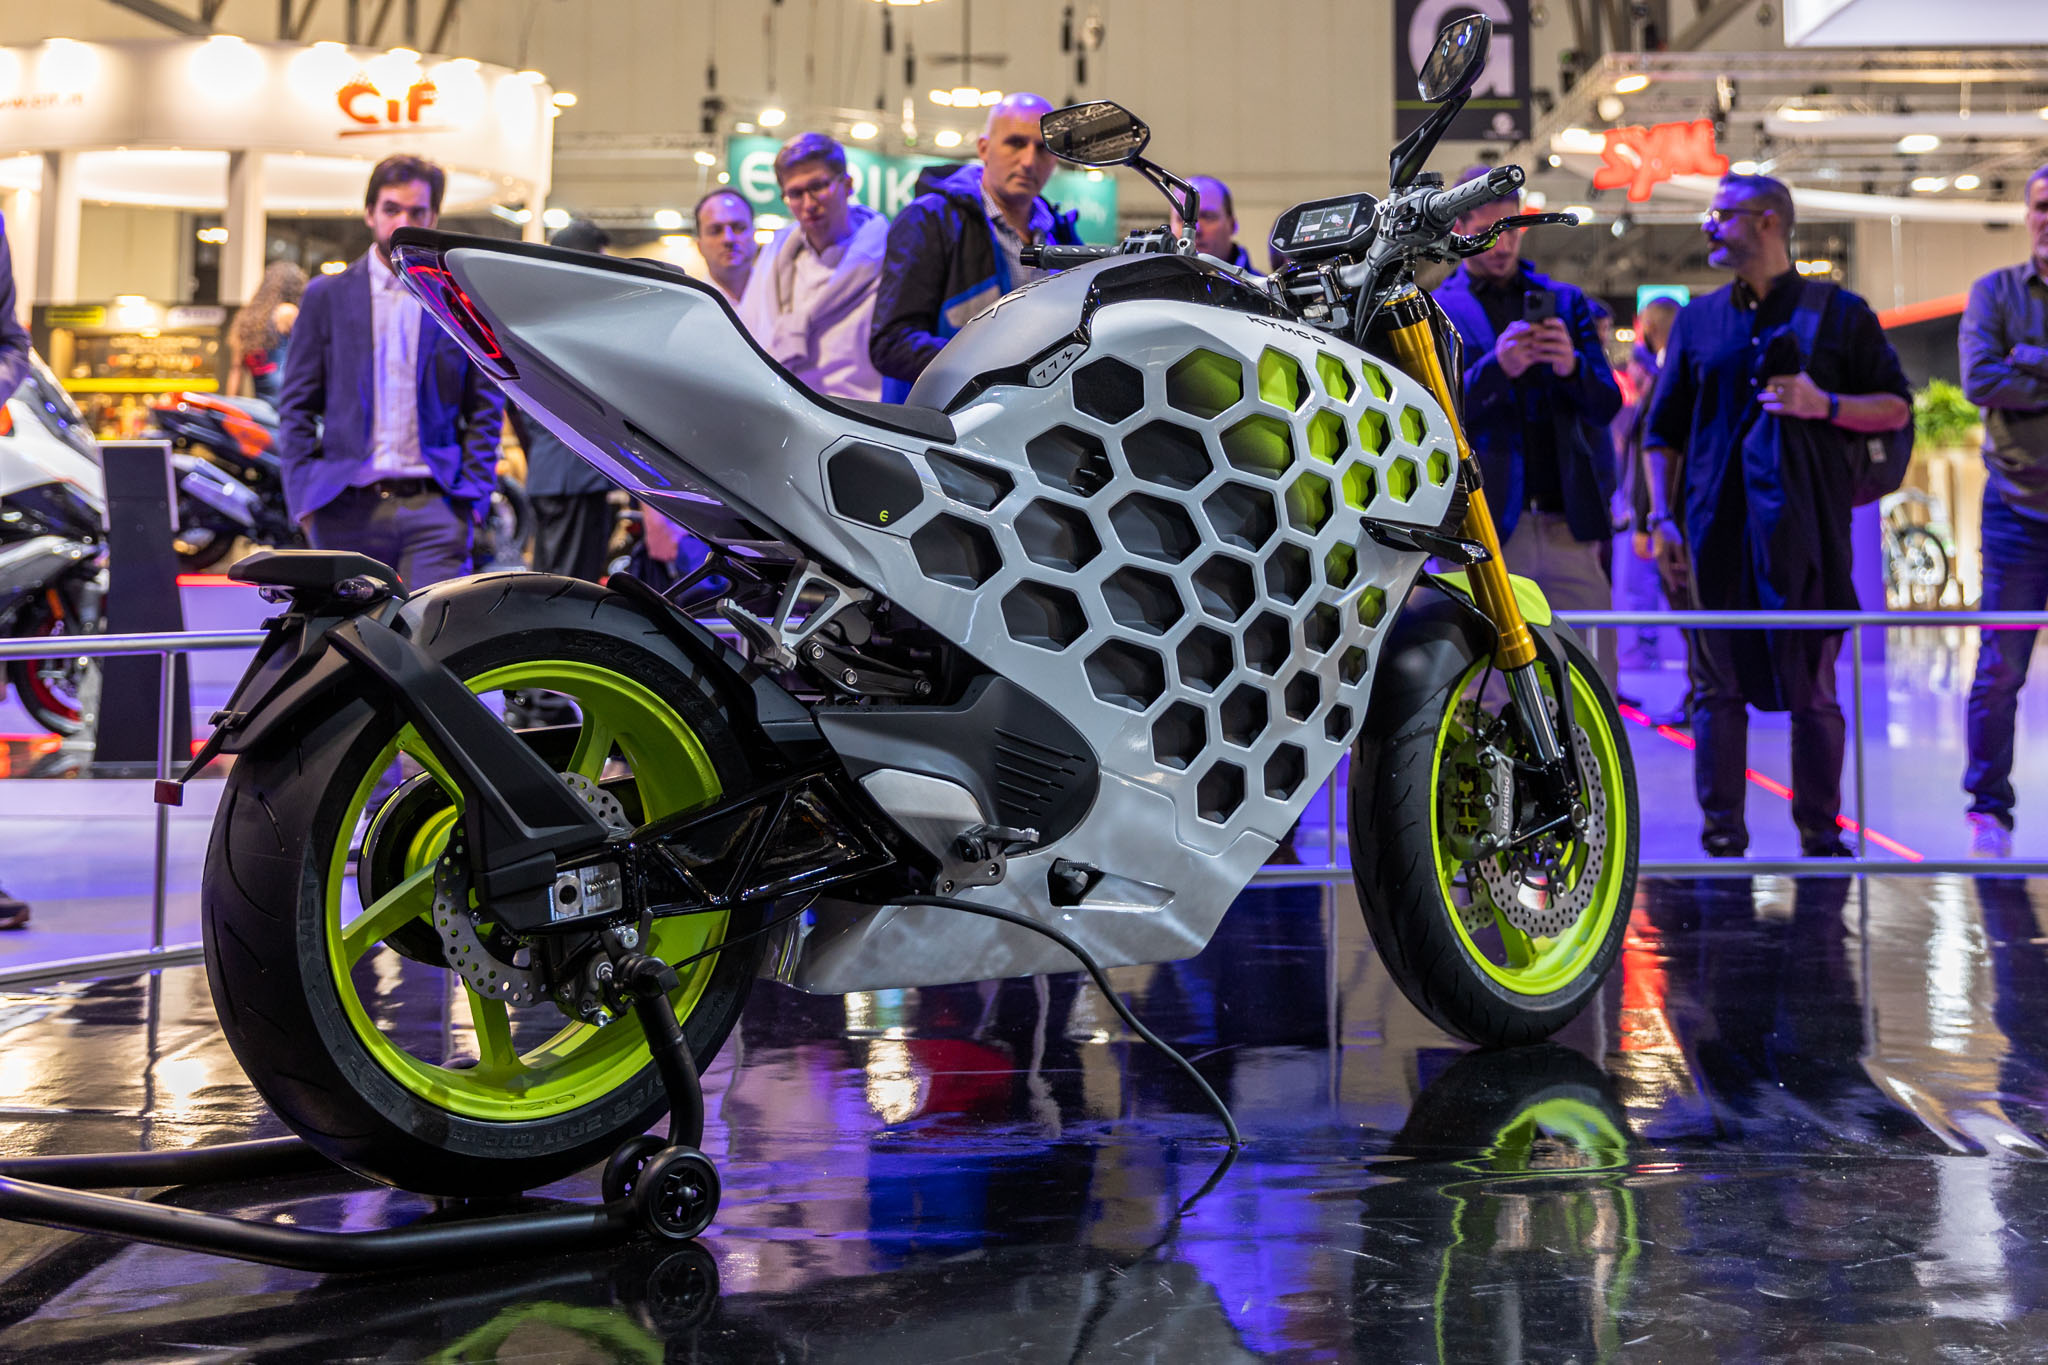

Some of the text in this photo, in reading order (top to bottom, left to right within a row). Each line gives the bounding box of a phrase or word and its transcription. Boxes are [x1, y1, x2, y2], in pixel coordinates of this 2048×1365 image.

[1593, 118, 1729, 203] SYM
[1246, 315, 1327, 345] KYMCO
[1501, 775, 1510, 830] brembo
